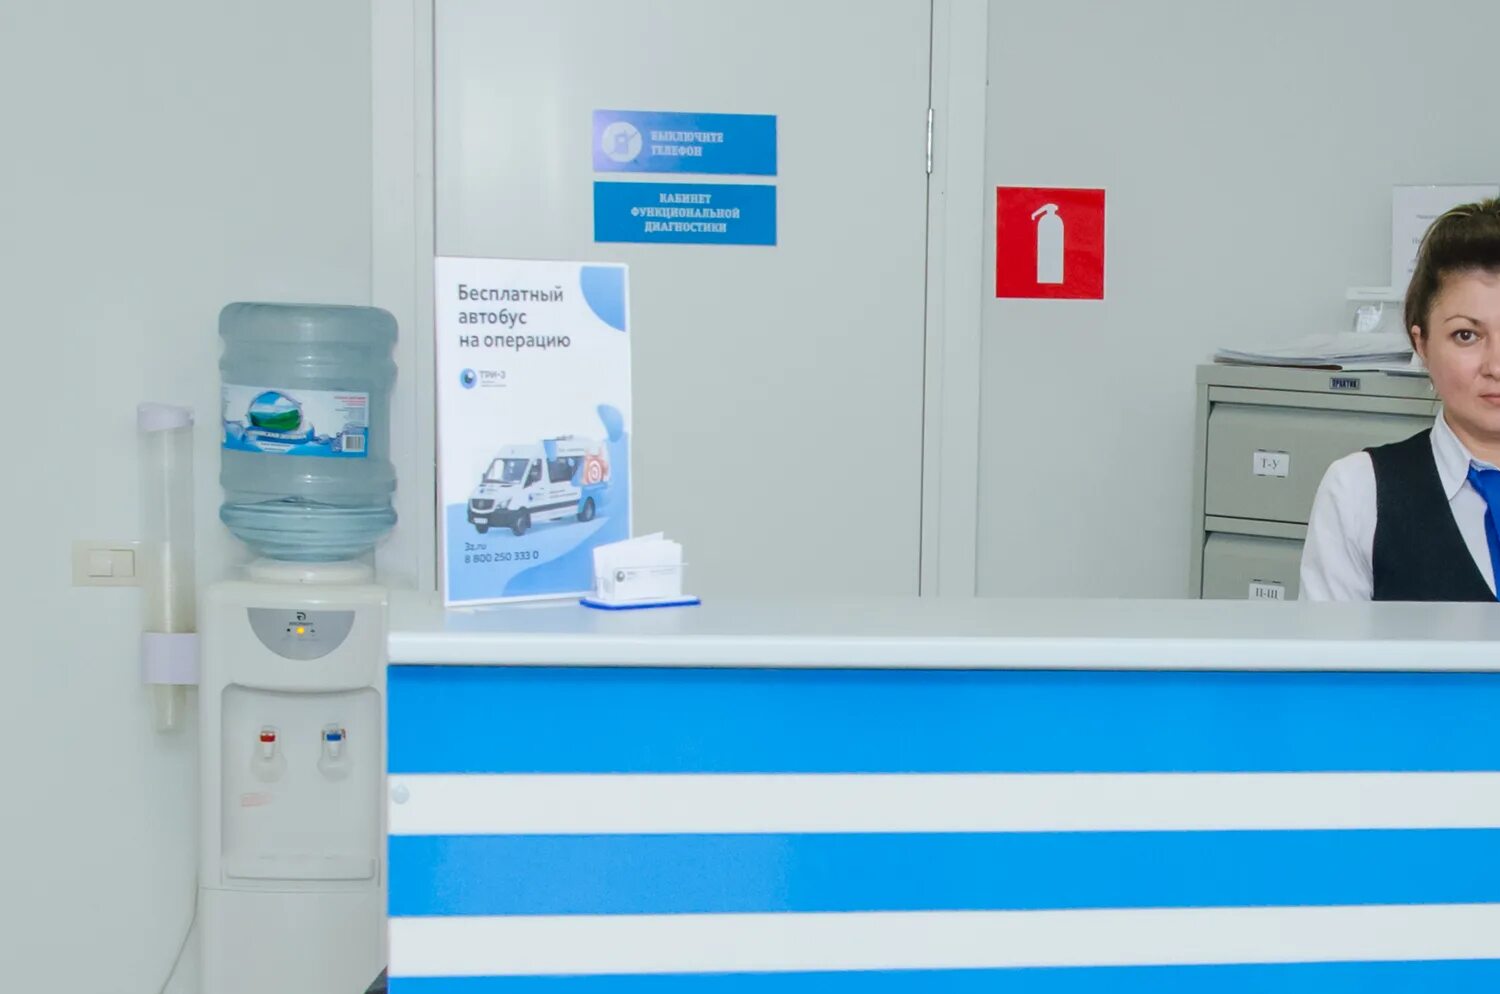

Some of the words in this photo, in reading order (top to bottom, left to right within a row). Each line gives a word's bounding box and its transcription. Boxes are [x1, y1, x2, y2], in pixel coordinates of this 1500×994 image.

[650, 131, 724, 143] ВЫКЛЮЧИТЕ
[651, 144, 703, 157] ТЕЛЕФОН
[659, 193, 712, 204] КАБИНЕТ
[630, 206, 740, 219] ФУНКЦИОНАЛЬНОЙ
[644, 221, 727, 233] ДИАГНОСТИКИ
[458, 284, 563, 302] Бесплатный
[458, 308, 527, 329] автобус
[459, 335, 479, 348] на
[484, 335, 571, 352] операцию
[465, 555, 471, 564] 8
[473, 553, 492, 563] 800
[494, 552, 512, 561] 250
[514, 551, 530, 560] 333
[533, 550, 539, 559] 0
